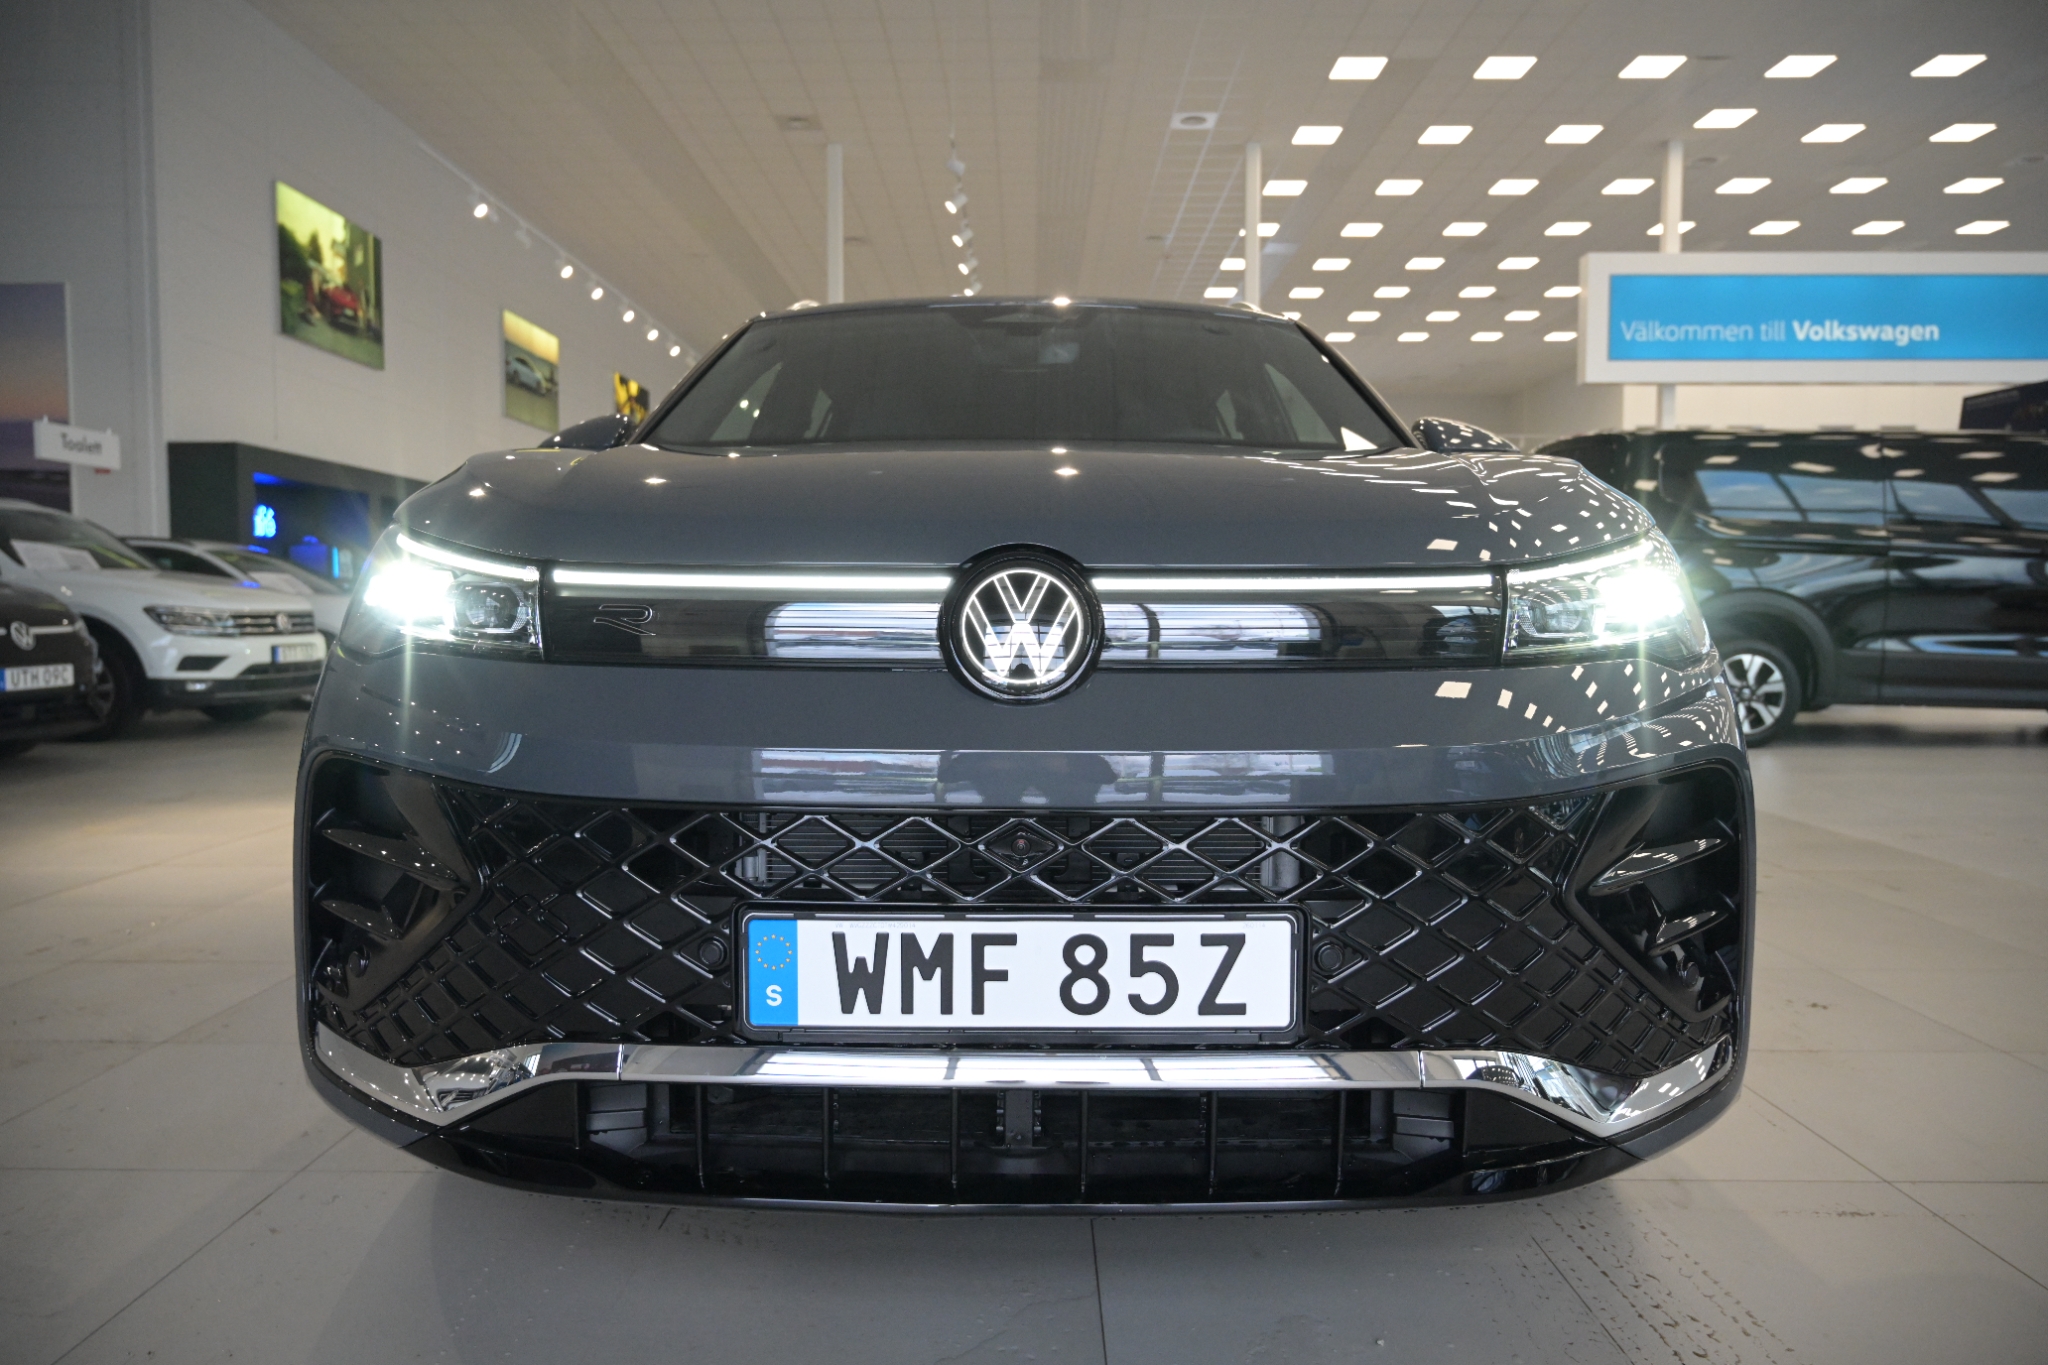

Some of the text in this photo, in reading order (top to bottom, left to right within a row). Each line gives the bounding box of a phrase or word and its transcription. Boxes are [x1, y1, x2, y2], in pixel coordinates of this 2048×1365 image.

[1620, 319, 1940, 347] Välkommen till Volkswagen
[831, 931, 1247, 1016] WMF 85Z
[765, 984, 783, 1007] S
